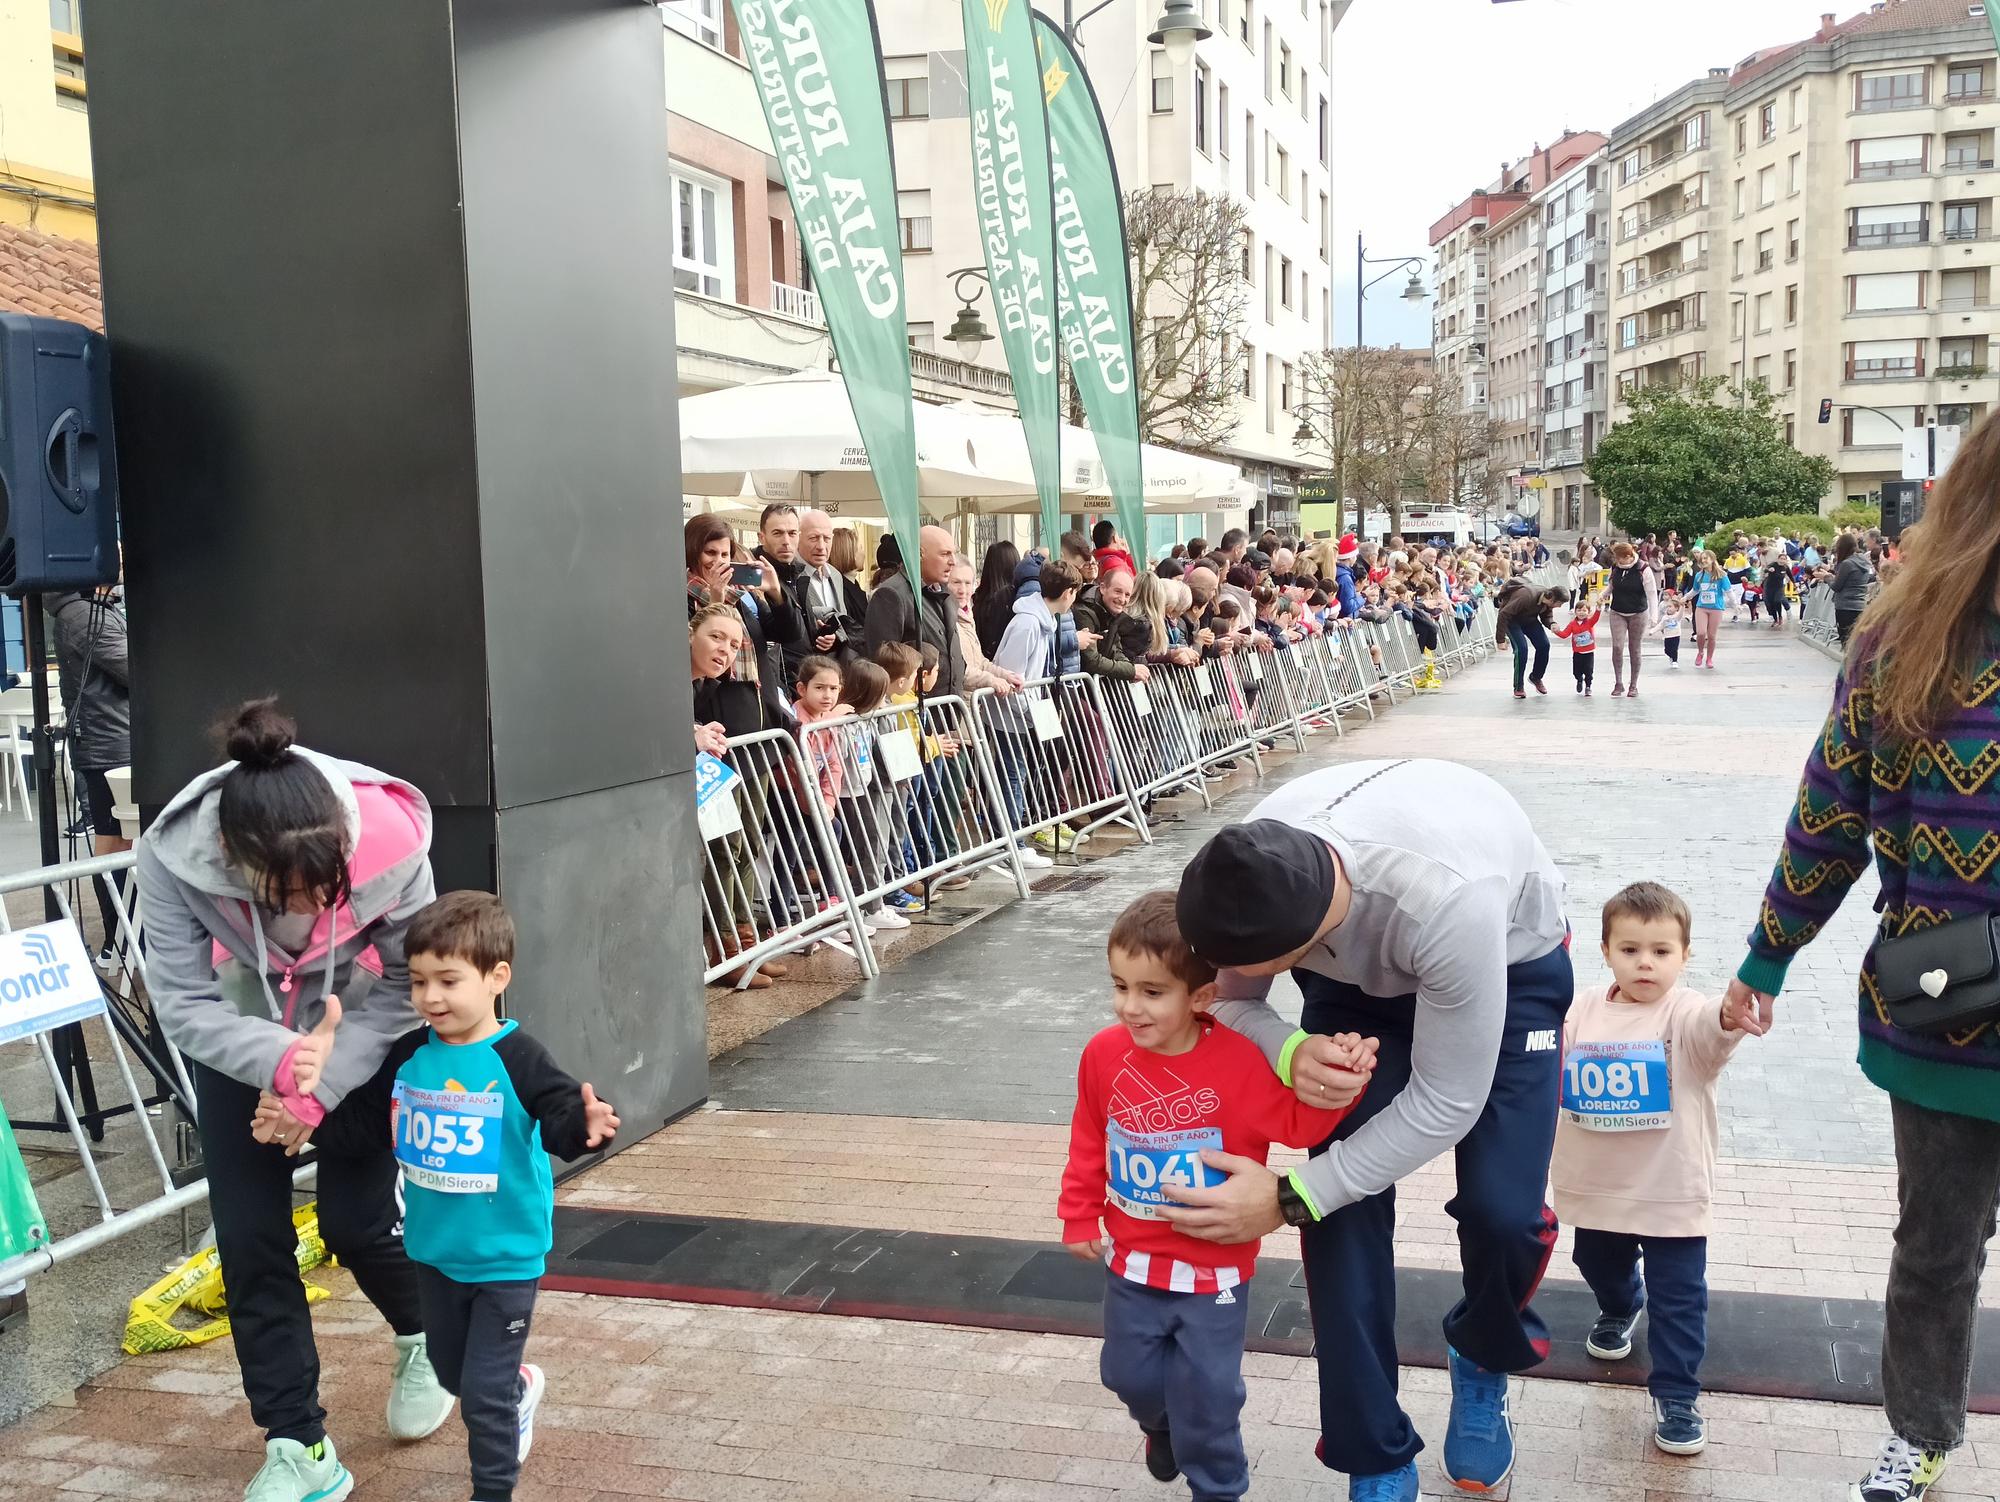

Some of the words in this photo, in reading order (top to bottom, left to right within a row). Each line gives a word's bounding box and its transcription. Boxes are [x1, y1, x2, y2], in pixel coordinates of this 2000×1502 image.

[843, 447, 868, 456] CERVE
[840, 457, 871, 466] ALHAMB
[1150, 477, 1187, 488] limpio
[1400, 520, 1445, 528] MBULANCIA
[0, 963, 70, 1004] onar
[1525, 1029, 1557, 1052] NIKE
[1618, 1043, 1629, 1051] DE
[1567, 1061, 1650, 1098] 1081
[437, 1094, 451, 1103] FIN
[454, 1094, 466, 1103] DE
[1578, 1099, 1641, 1111] LORENZO
[1119, 1087, 1221, 1134] didas
[1593, 1115, 1659, 1128] PDMSiero
[401, 1105, 484, 1156] 1053
[1153, 1135, 1168, 1144] FIN
[1171, 1132, 1184, 1141] DE
[421, 1154, 446, 1168] LEO
[1115, 1144, 1206, 1189] 1041
[420, 1170, 484, 1189] PDMSiero
[1133, 1188, 1178, 1203] FABI
